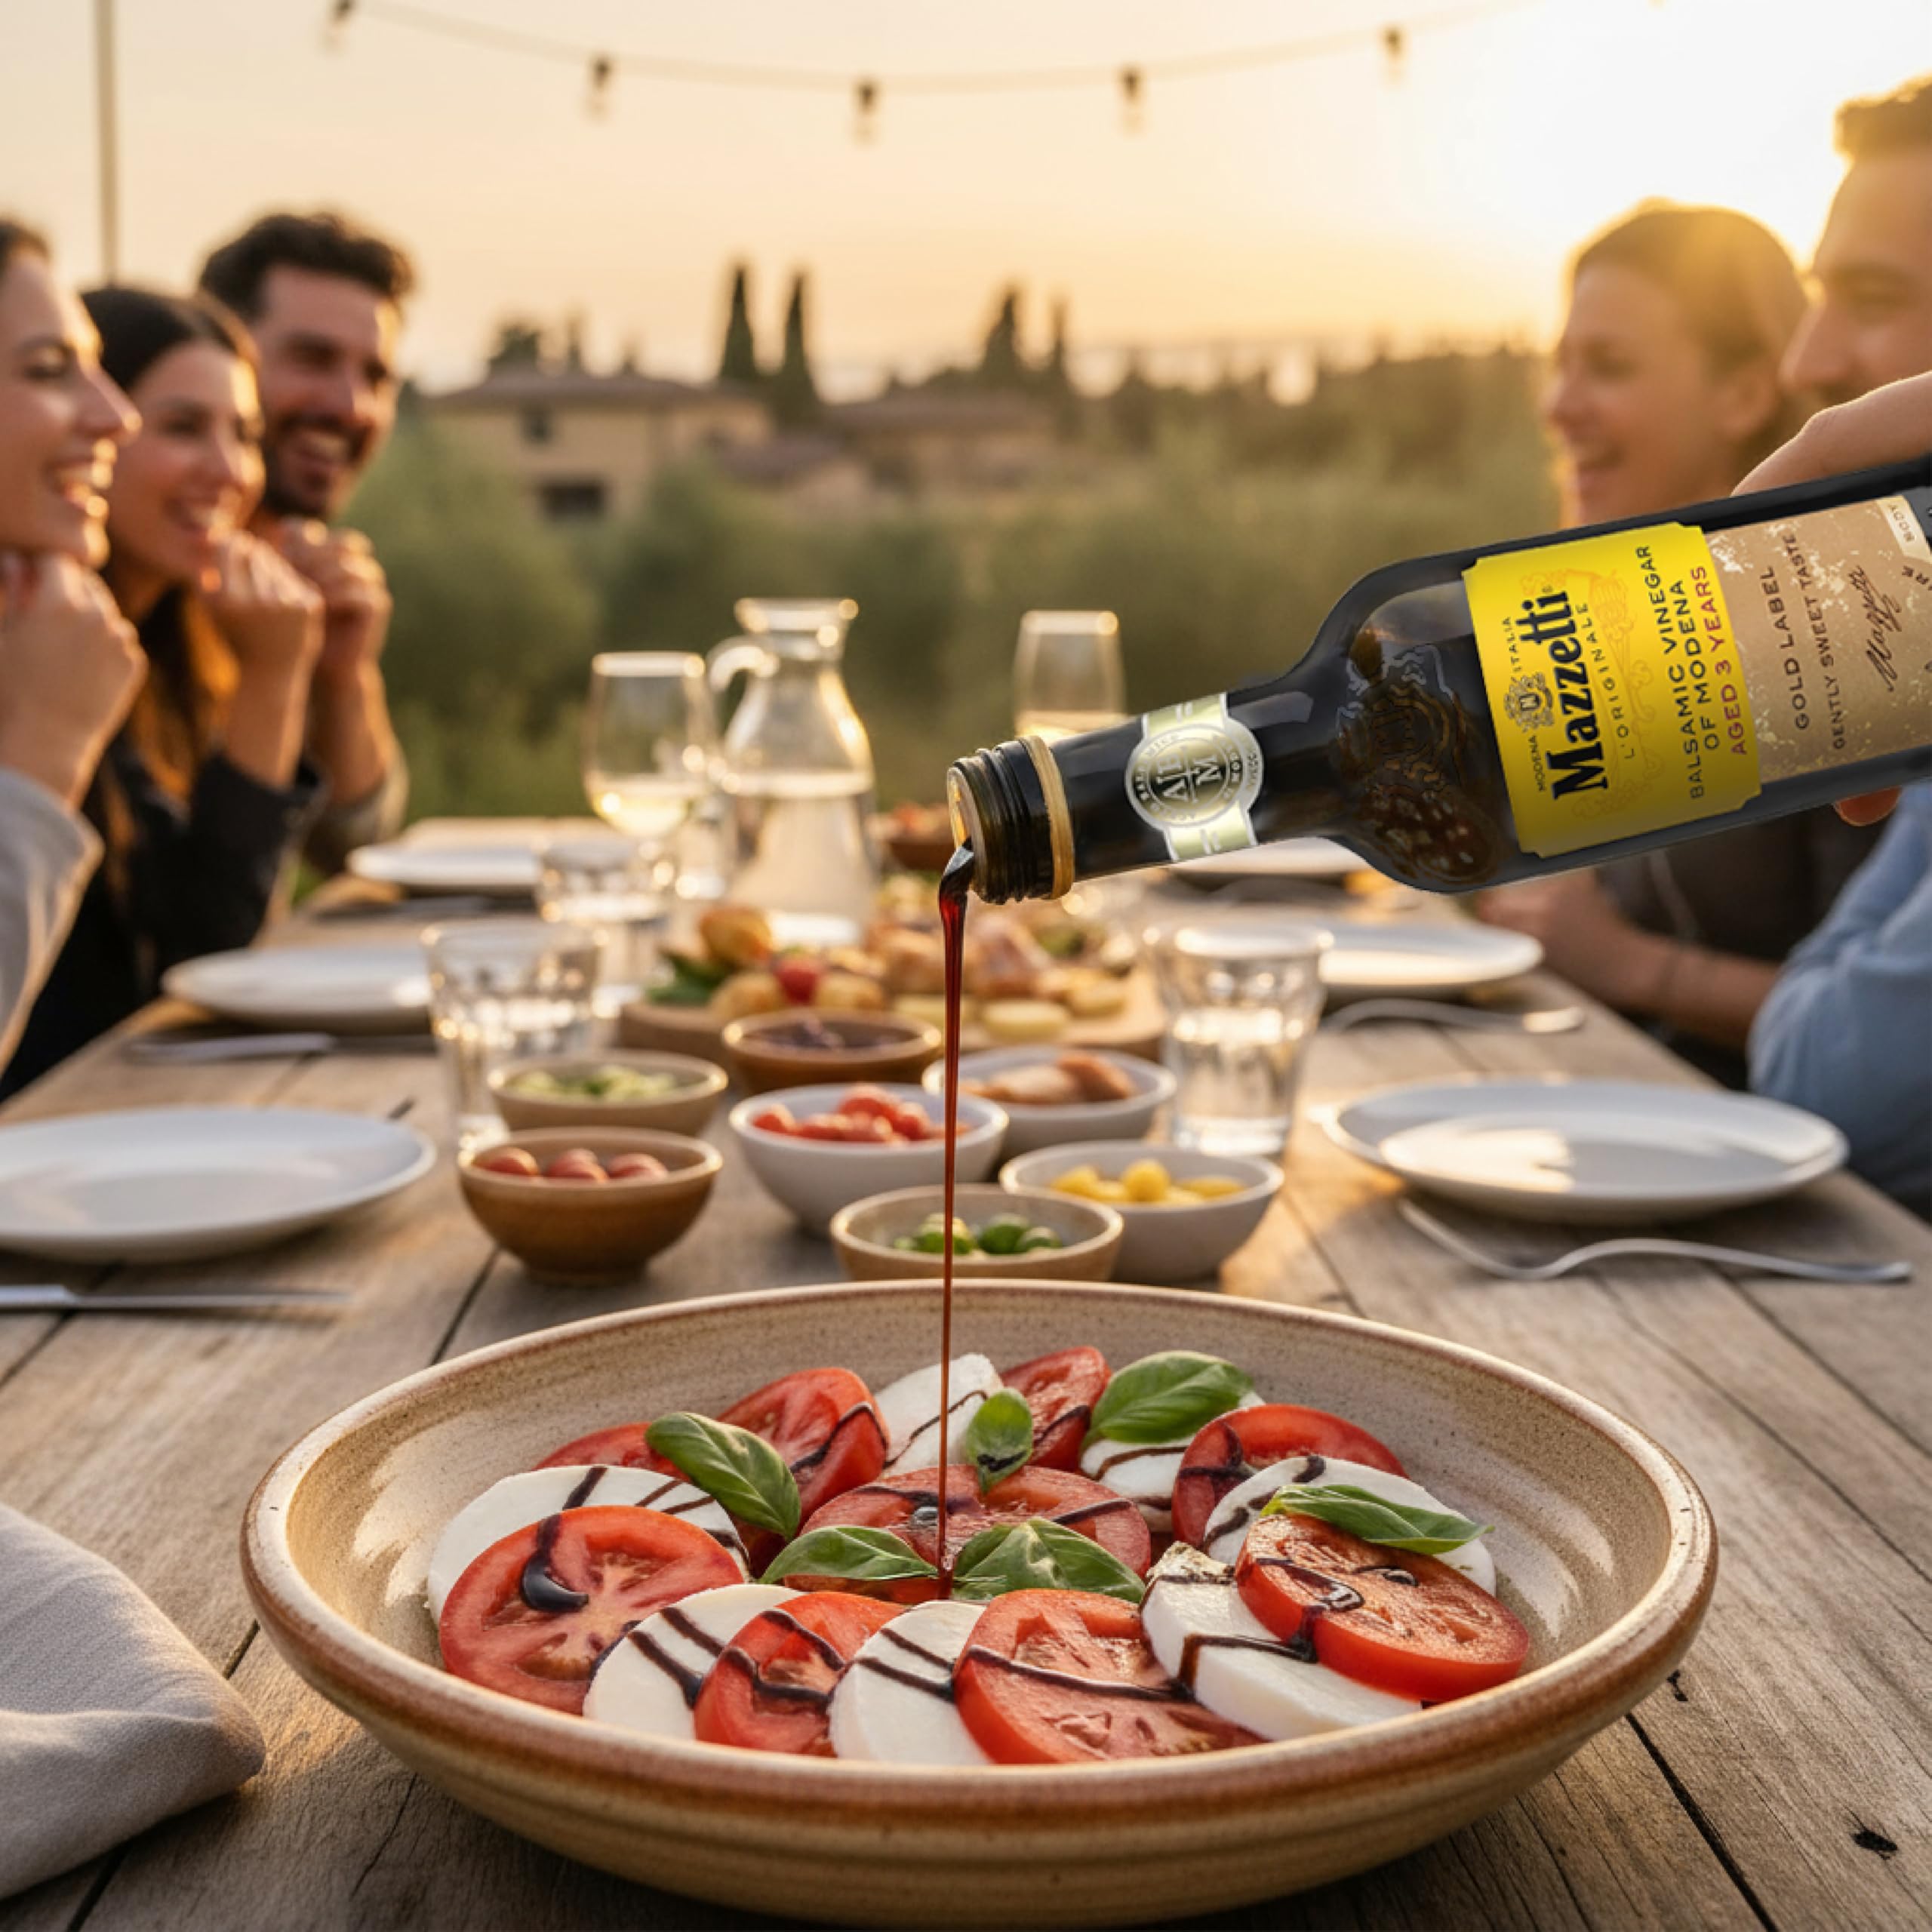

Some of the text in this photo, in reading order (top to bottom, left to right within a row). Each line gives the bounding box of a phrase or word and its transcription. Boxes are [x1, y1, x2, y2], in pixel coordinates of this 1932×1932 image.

[1502, 616, 1521, 672] ITALIA
[1515, 590, 1608, 800] Mazzetti
[1575, 603, 1635, 759] L'ORIGINALE
[1636, 546, 1703, 800] BALSAMIC VINEGAR
[1669, 580, 1720, 750] OF MODENA
[1690, 566, 1747, 755] AGED 3 YEARS
[1759, 566, 1810, 731] GOLD LABEL
[1782, 533, 1845, 750] GENTLY SWEET TASTE
[1528, 734, 1546, 792] MODENA
